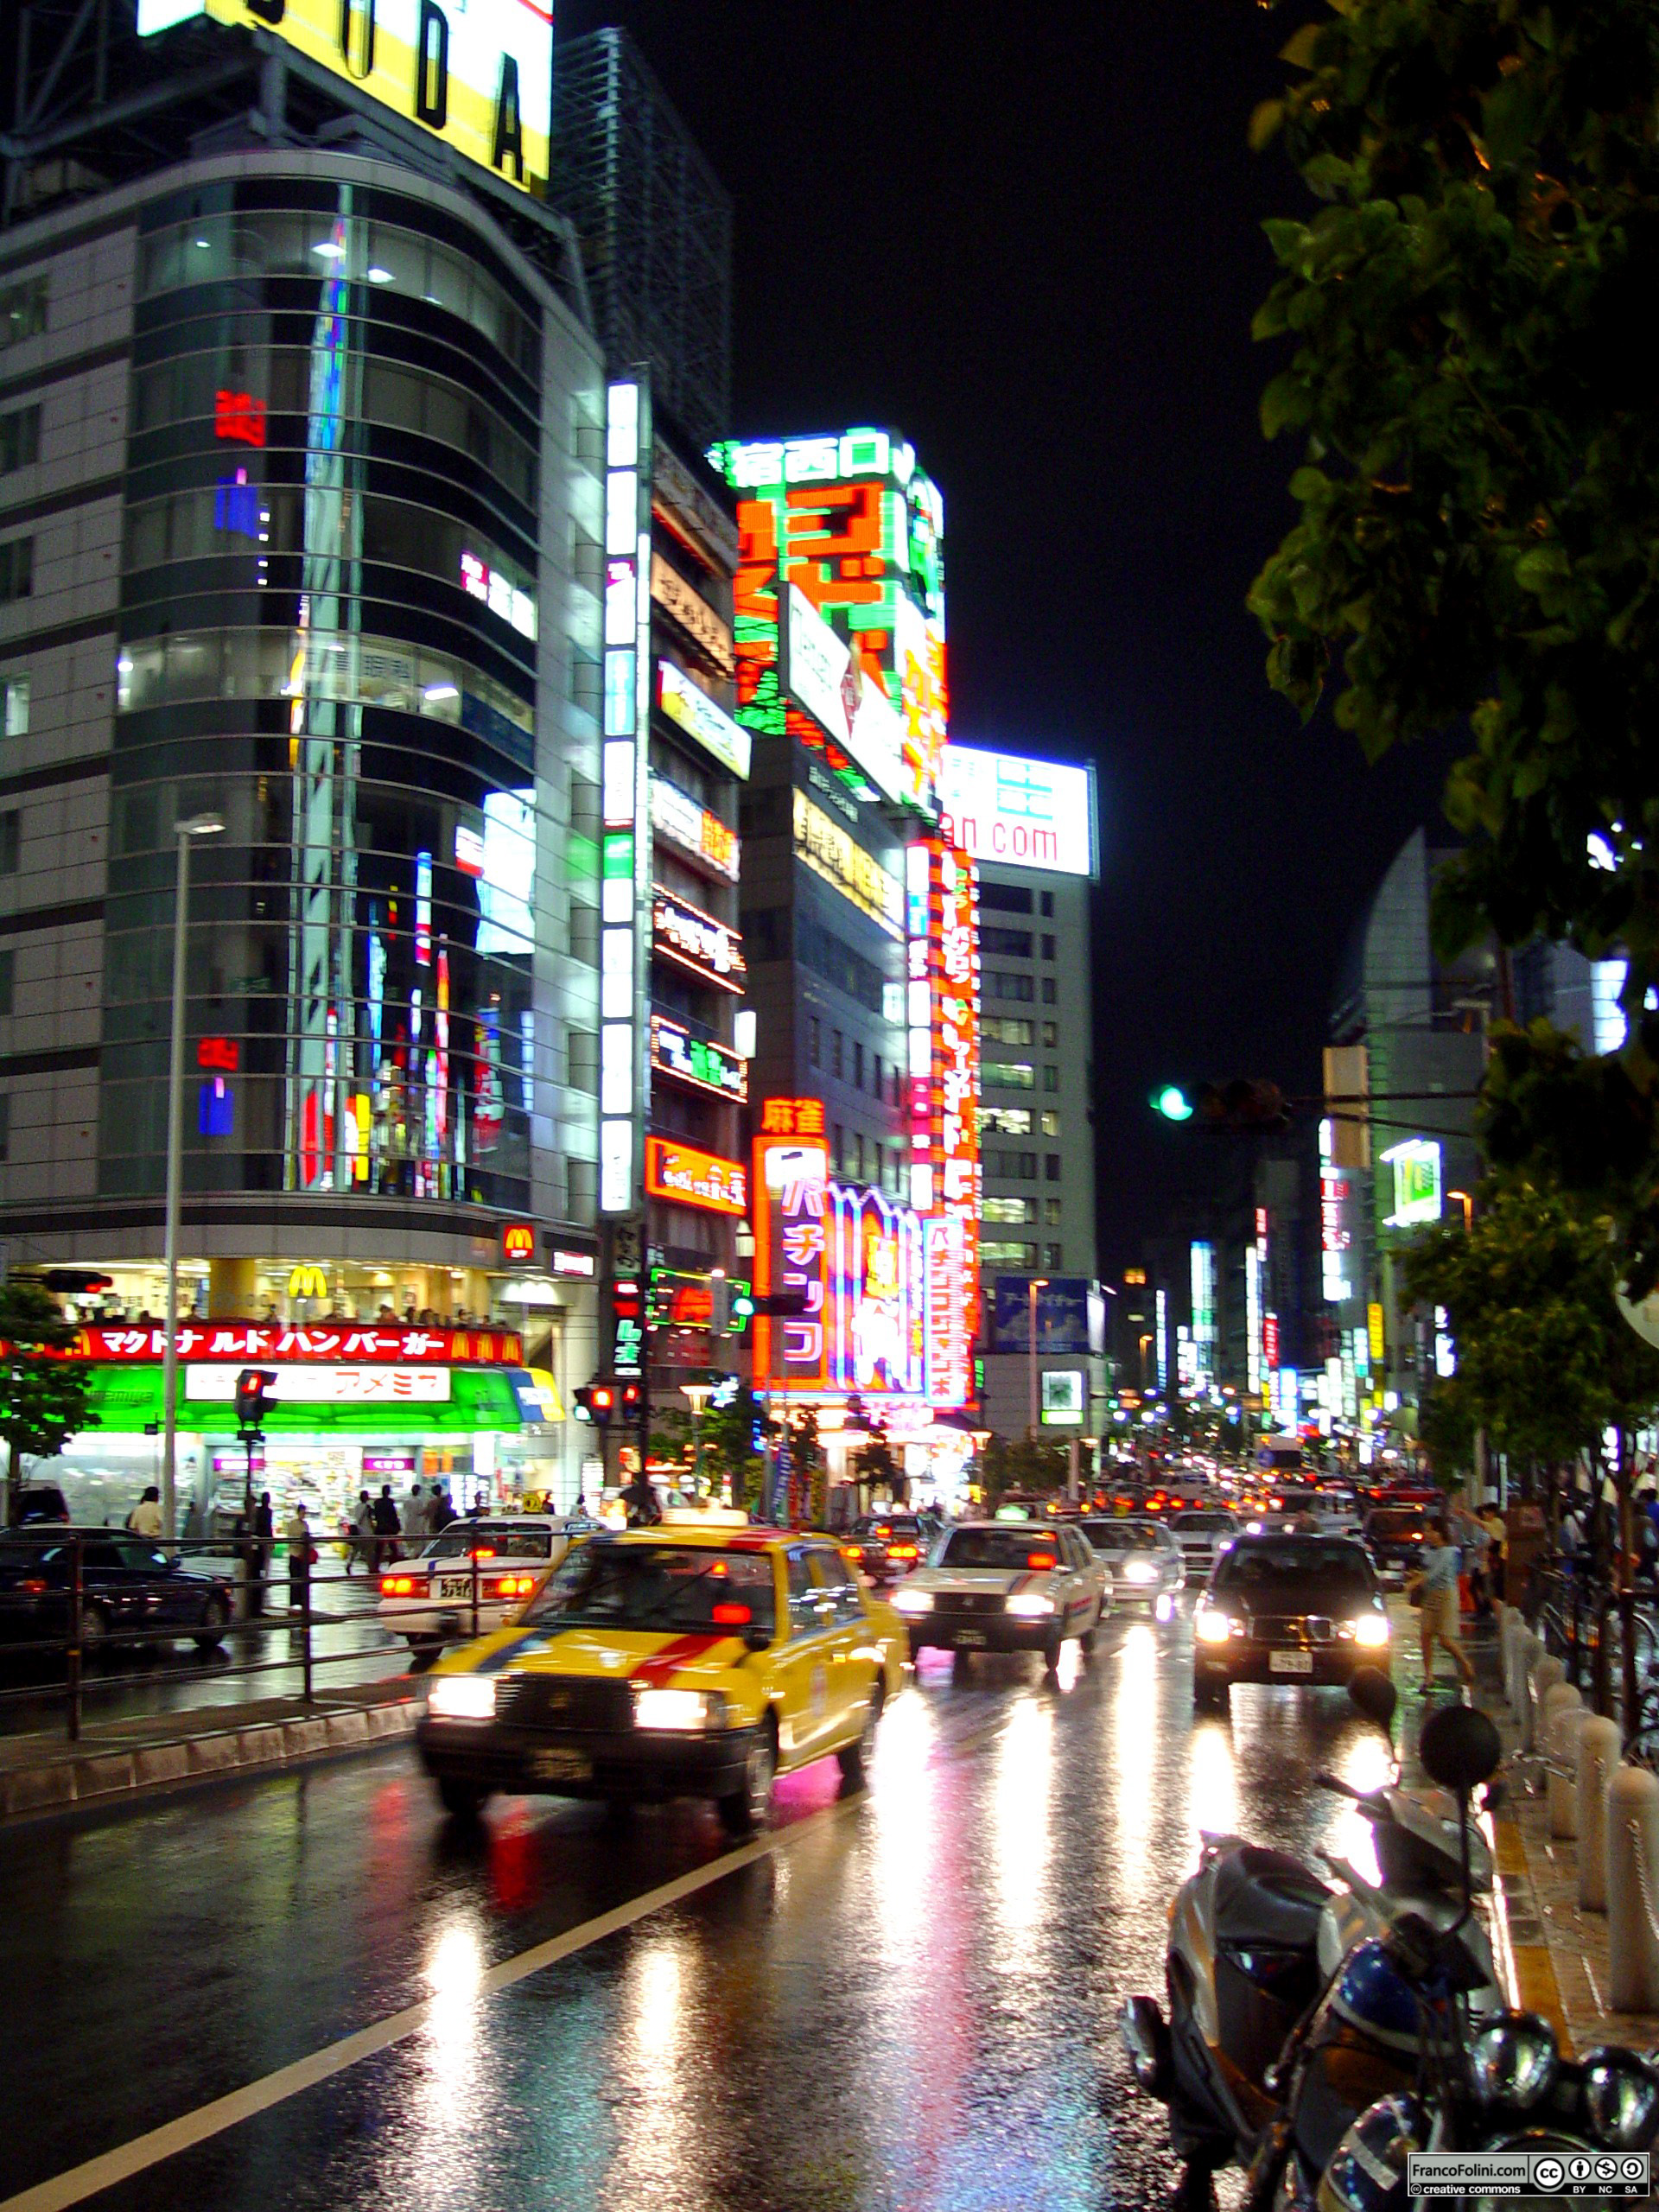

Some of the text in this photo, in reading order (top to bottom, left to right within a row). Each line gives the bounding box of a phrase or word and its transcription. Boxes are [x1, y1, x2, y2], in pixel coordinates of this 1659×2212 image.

[993, 822, 1057, 861] com
[761, 1097, 824, 1134] 麻雀
[781, 1177, 825, 1362] パチンコ
